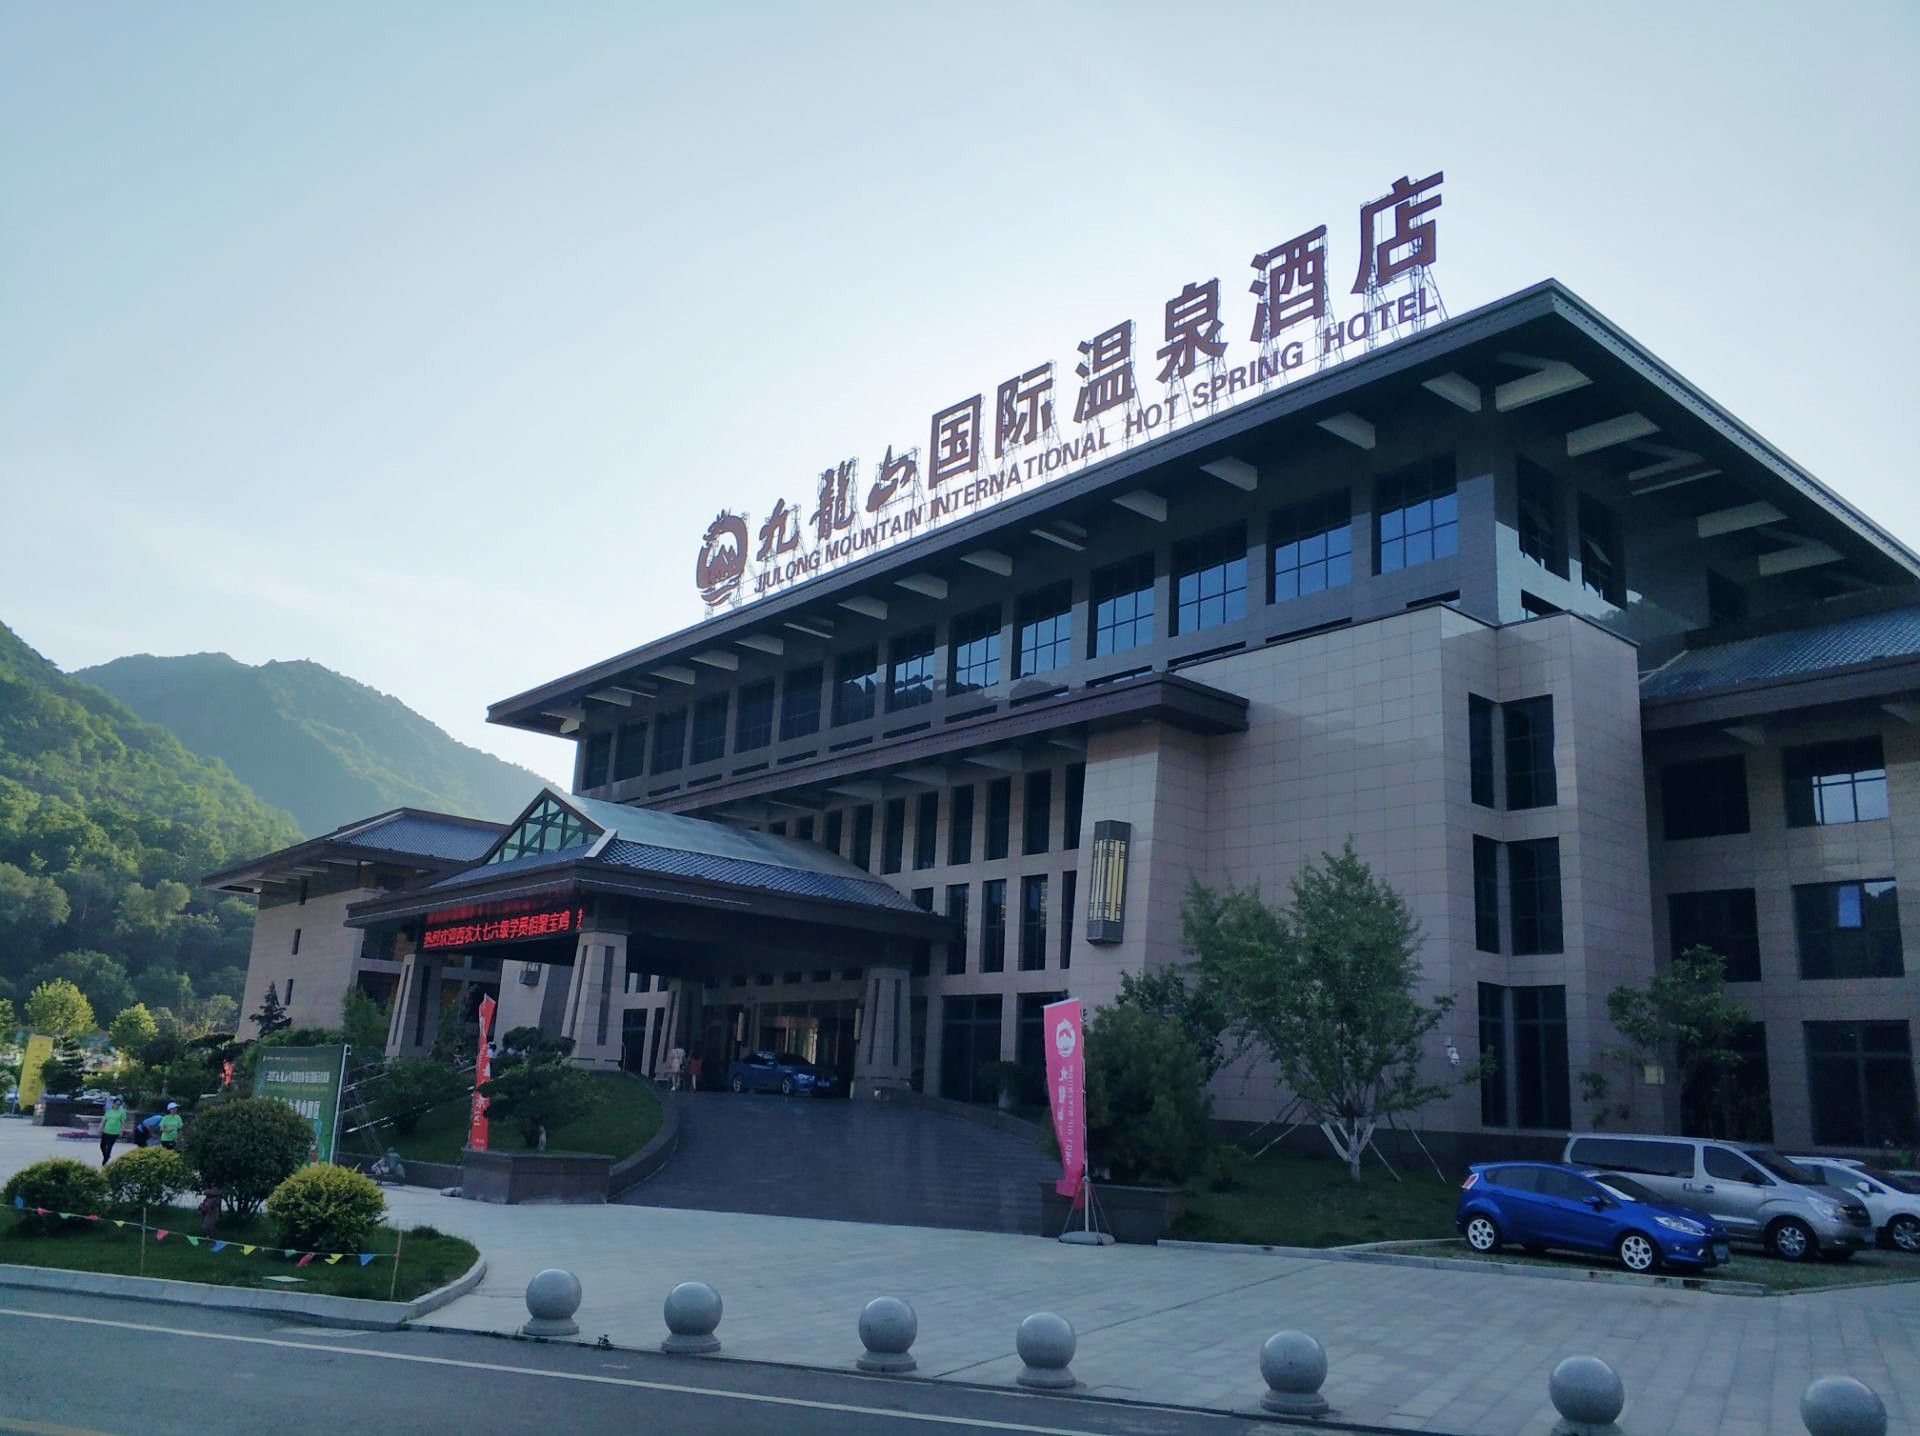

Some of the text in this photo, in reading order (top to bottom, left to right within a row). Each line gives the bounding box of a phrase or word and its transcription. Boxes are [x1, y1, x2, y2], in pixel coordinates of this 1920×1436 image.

[753, 287, 1439, 594] JIULONG MOUNTAIN INTERNATIONAL HOT SPRING HOTEL
